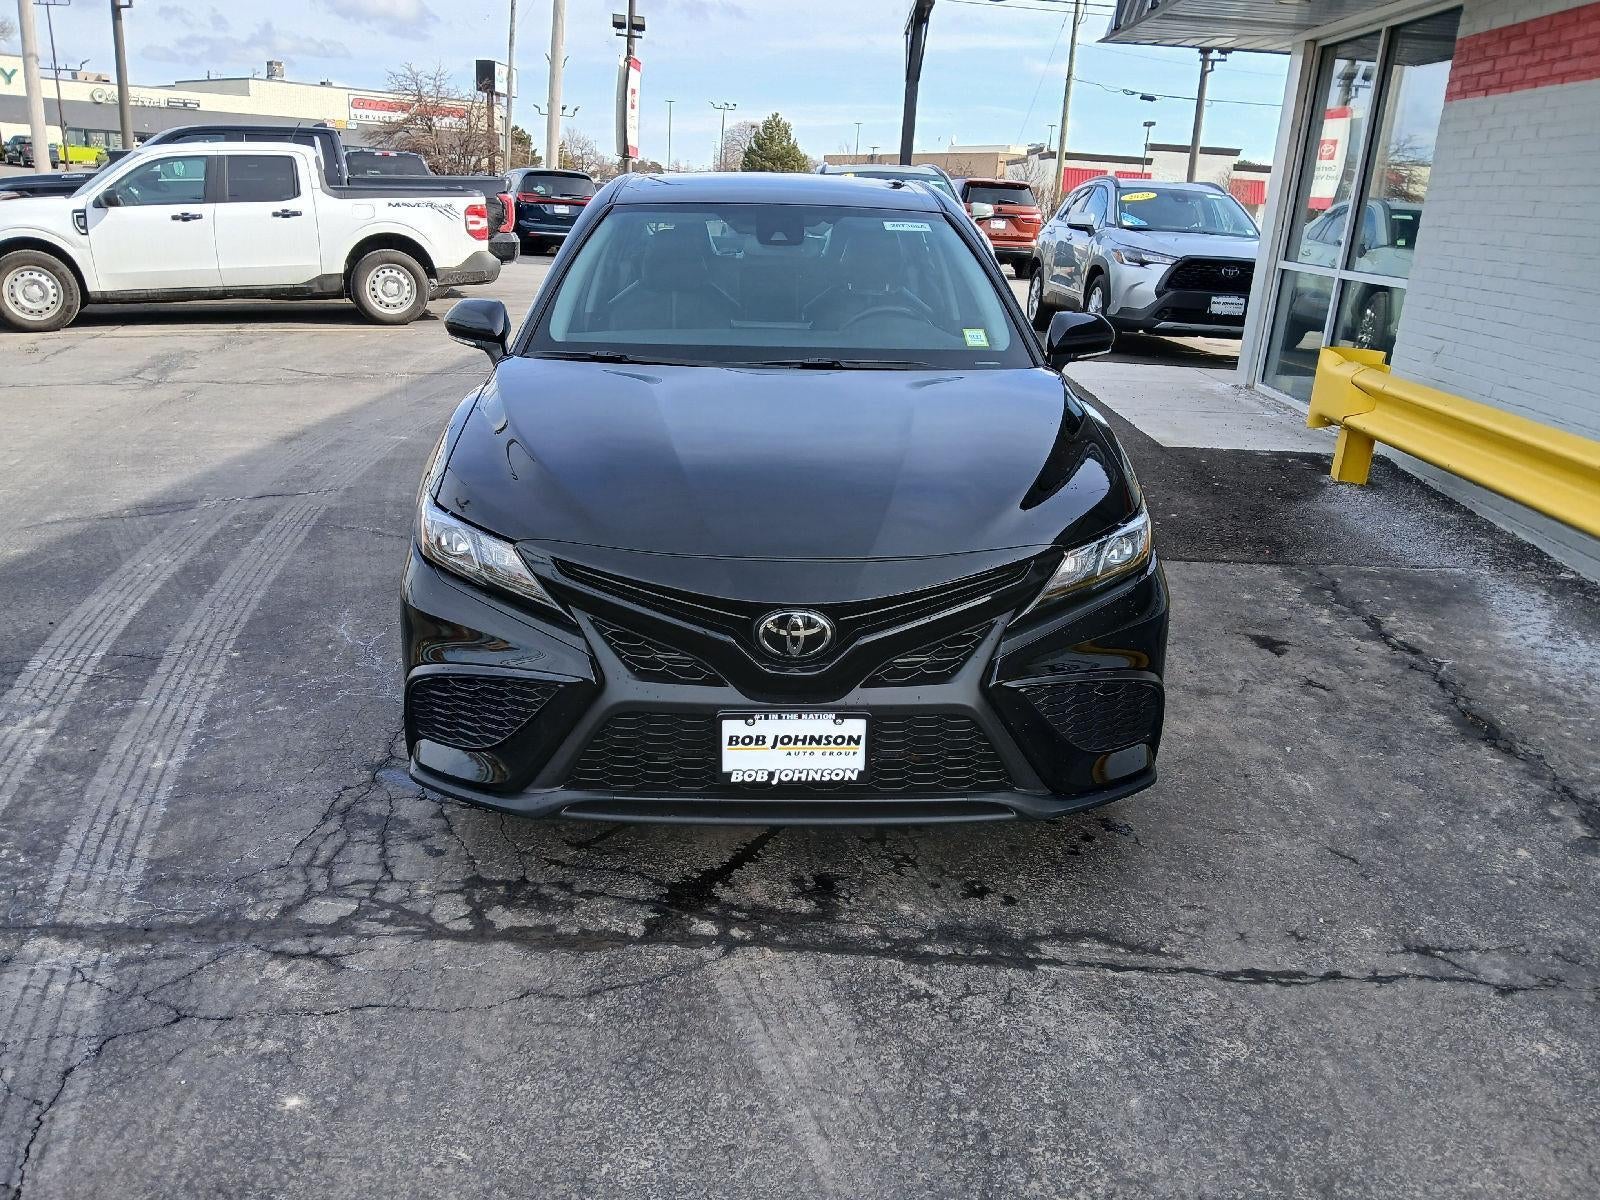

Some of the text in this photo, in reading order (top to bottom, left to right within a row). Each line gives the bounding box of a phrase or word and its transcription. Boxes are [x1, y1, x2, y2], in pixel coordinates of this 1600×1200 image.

[727, 734, 862, 749] BOB JOHNSON
[730, 768, 859, 785] BOB JOHNSON
